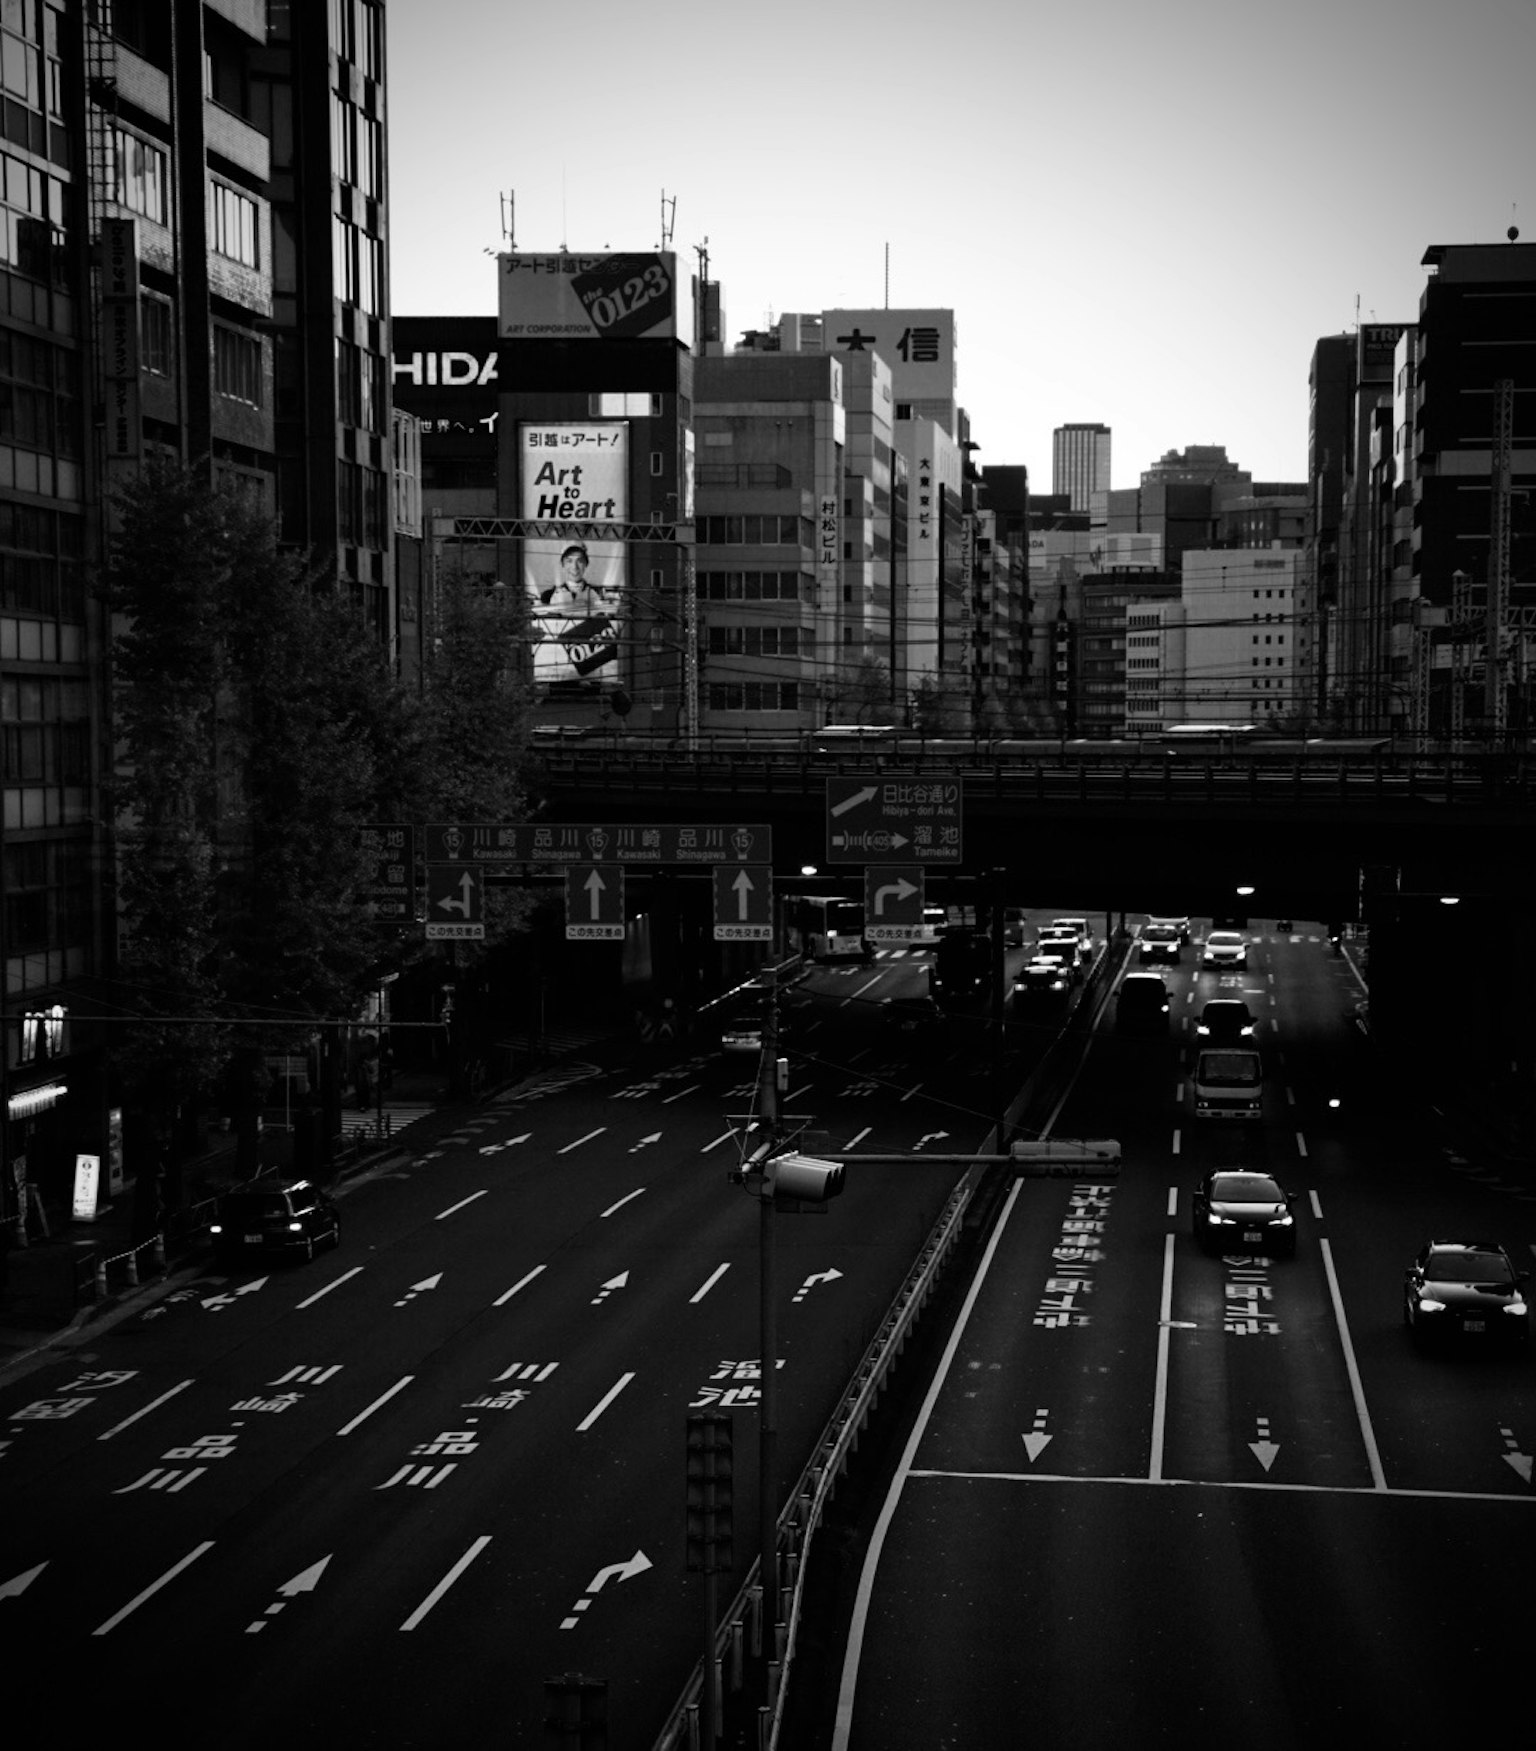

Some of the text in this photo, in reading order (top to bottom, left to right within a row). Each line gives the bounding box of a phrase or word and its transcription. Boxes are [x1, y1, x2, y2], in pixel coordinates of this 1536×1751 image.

[592, 265, 669, 328] 0123
[506, 325, 592, 333] ART CORPORATION
[534, 461, 583, 486] Art
[564, 486, 580, 499] to
[537, 494, 616, 519] Heart
[821, 501, 837, 564] 村松ビル
[882, 784, 959, 804] 日比谷通り
[446, 834, 460, 847] 15
[473, 829, 579, 847] 川崎 品川
[589, 834, 604, 847] 15
[617, 829, 723, 847] 川崎 品川
[735, 834, 750, 847] 15
[913, 825, 959, 845] 溜池
[473, 848, 581, 860] Kawasaki Shinagawa
[617, 848, 726, 860] Kawasaki Shinagawa
[913, 846, 959, 858] Tameike
